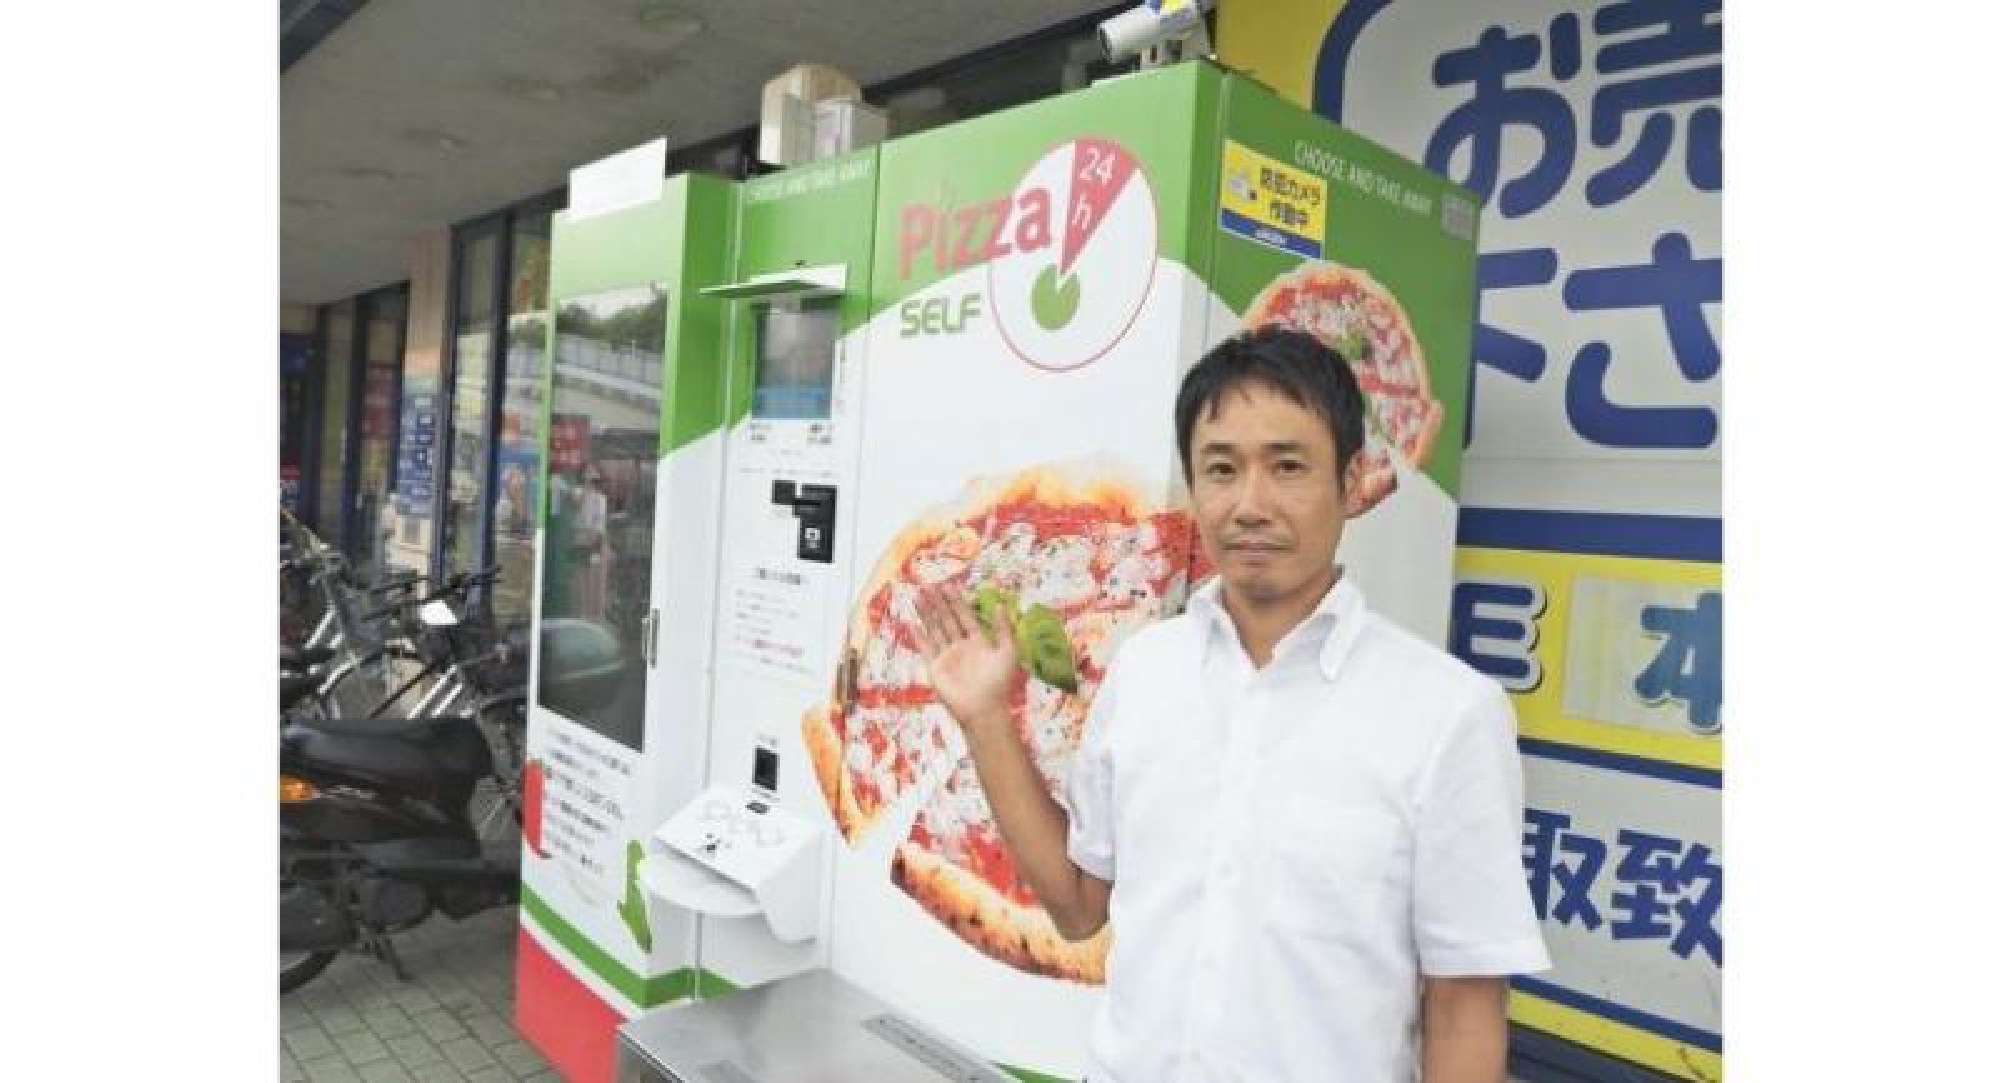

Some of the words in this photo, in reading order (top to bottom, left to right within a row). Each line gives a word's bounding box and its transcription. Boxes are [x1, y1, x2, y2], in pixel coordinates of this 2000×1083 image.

[1079, 147, 1117, 186] 24
[1294, 140, 1346, 181] CHOOSE
[1071, 193, 1093, 231] h
[897, 184, 1052, 282] Pizza
[900, 292, 981, 338] SELF
